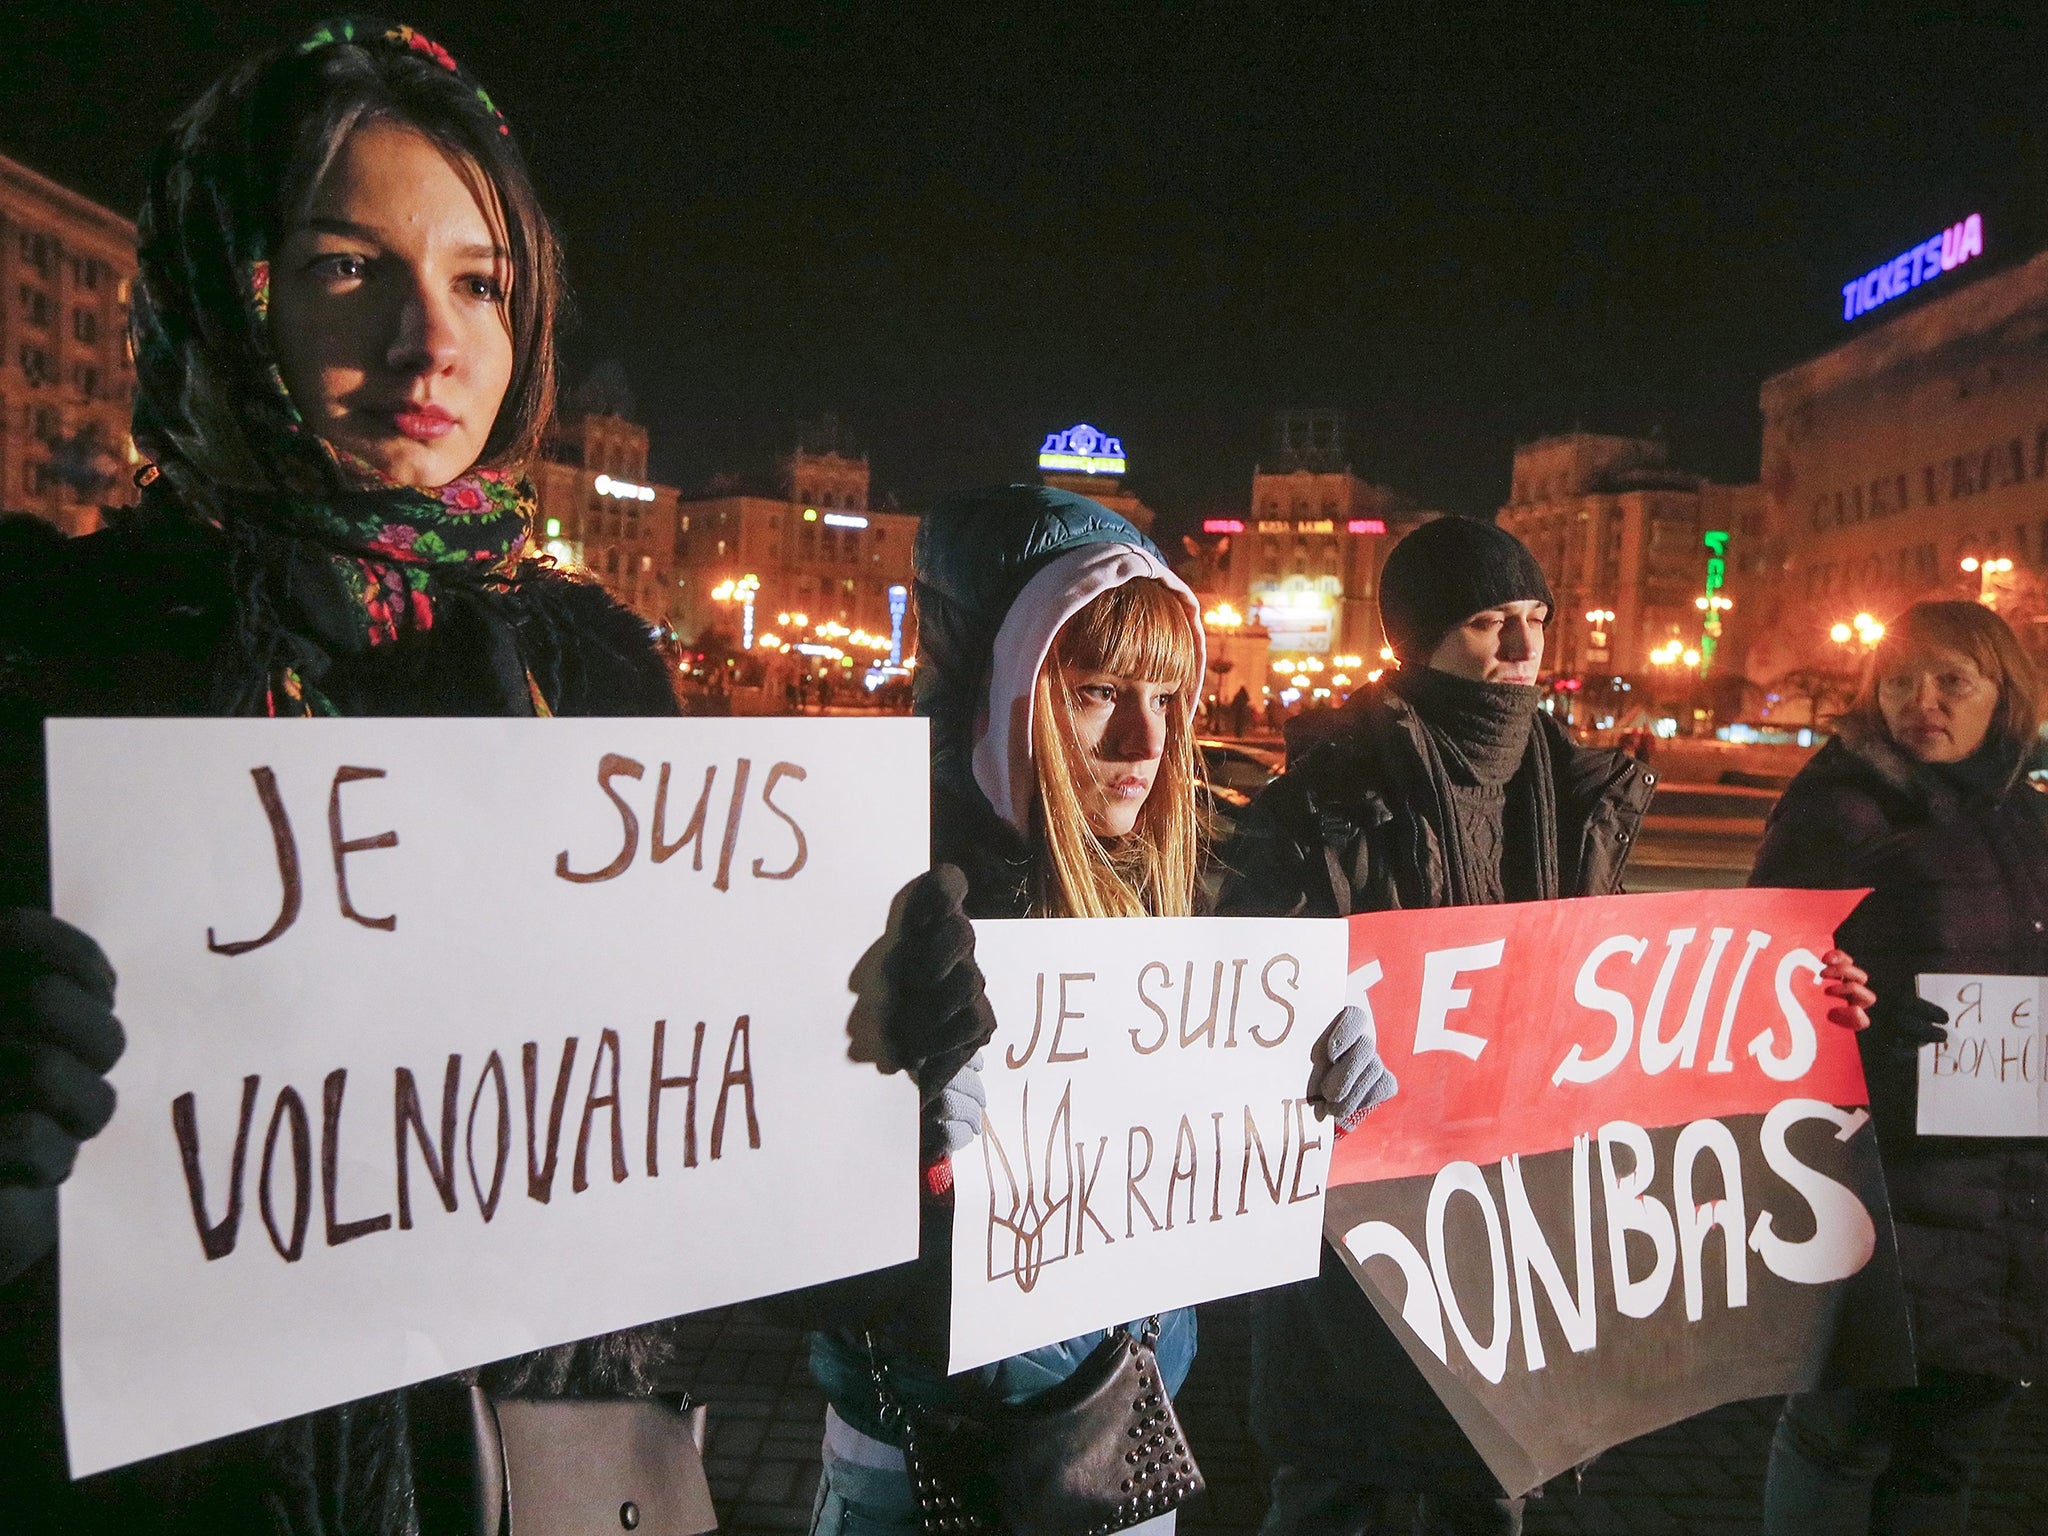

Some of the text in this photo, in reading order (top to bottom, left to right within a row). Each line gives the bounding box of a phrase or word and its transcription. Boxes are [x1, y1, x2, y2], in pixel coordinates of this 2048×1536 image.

[207, 752, 809, 956] JE SUIS
[1005, 952, 1301, 1070] JE SUIS
[1551, 926, 1826, 1088] SUIS
[1955, 982, 1984, 1028] Я
[171, 1014, 762, 1264] VOLNOVAHA
